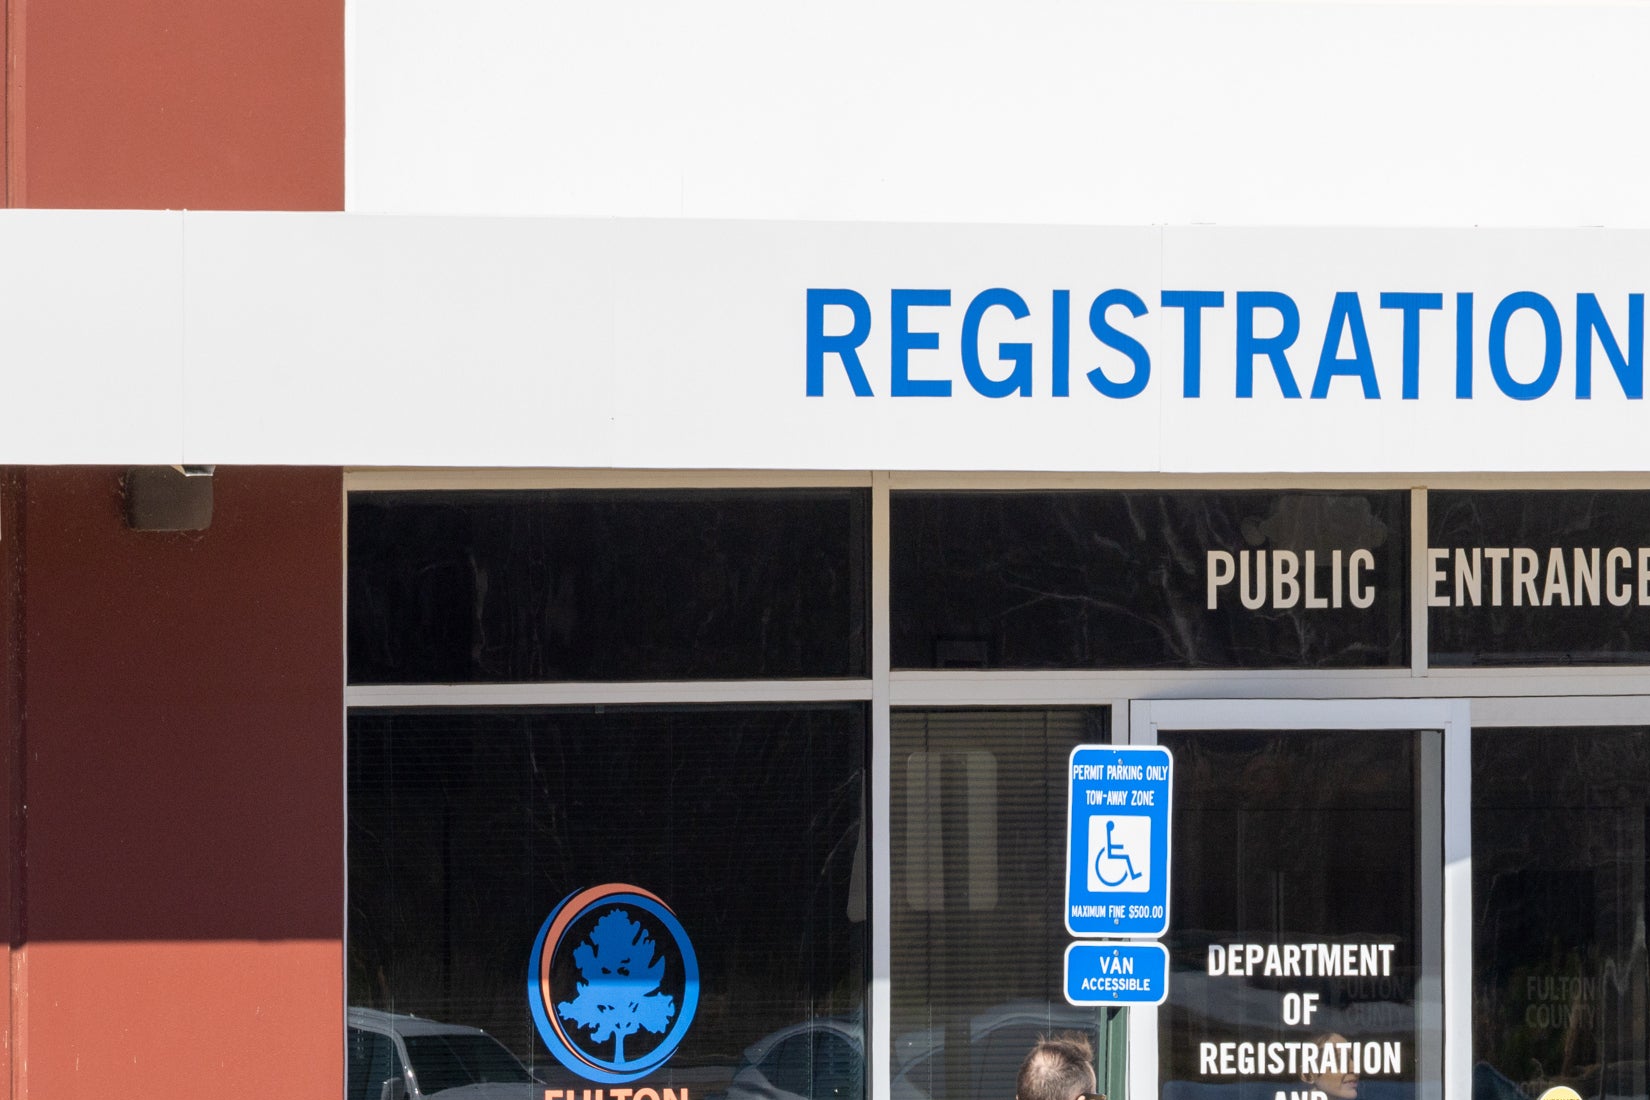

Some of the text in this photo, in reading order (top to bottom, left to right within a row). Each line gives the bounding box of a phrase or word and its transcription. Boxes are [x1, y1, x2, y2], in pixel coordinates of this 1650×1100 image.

[805, 287, 1645, 401] REGISTRATION
[1207, 549, 1376, 612] PUBLIC
[1073, 765, 1169, 781] PERMIT PARKING ONLY
[1086, 790, 1155, 806] TOW-AWAY ZONE
[1072, 905, 1163, 919] MAXIMUM FINE $500.00
[1099, 956, 1134, 975] VAN
[1208, 944, 1395, 977] DEPARTMENT
[1081, 977, 1150, 991] ACCESSIBLE
[1283, 993, 1320, 1025] OF
[1200, 1041, 1402, 1074] REGISTRATION
